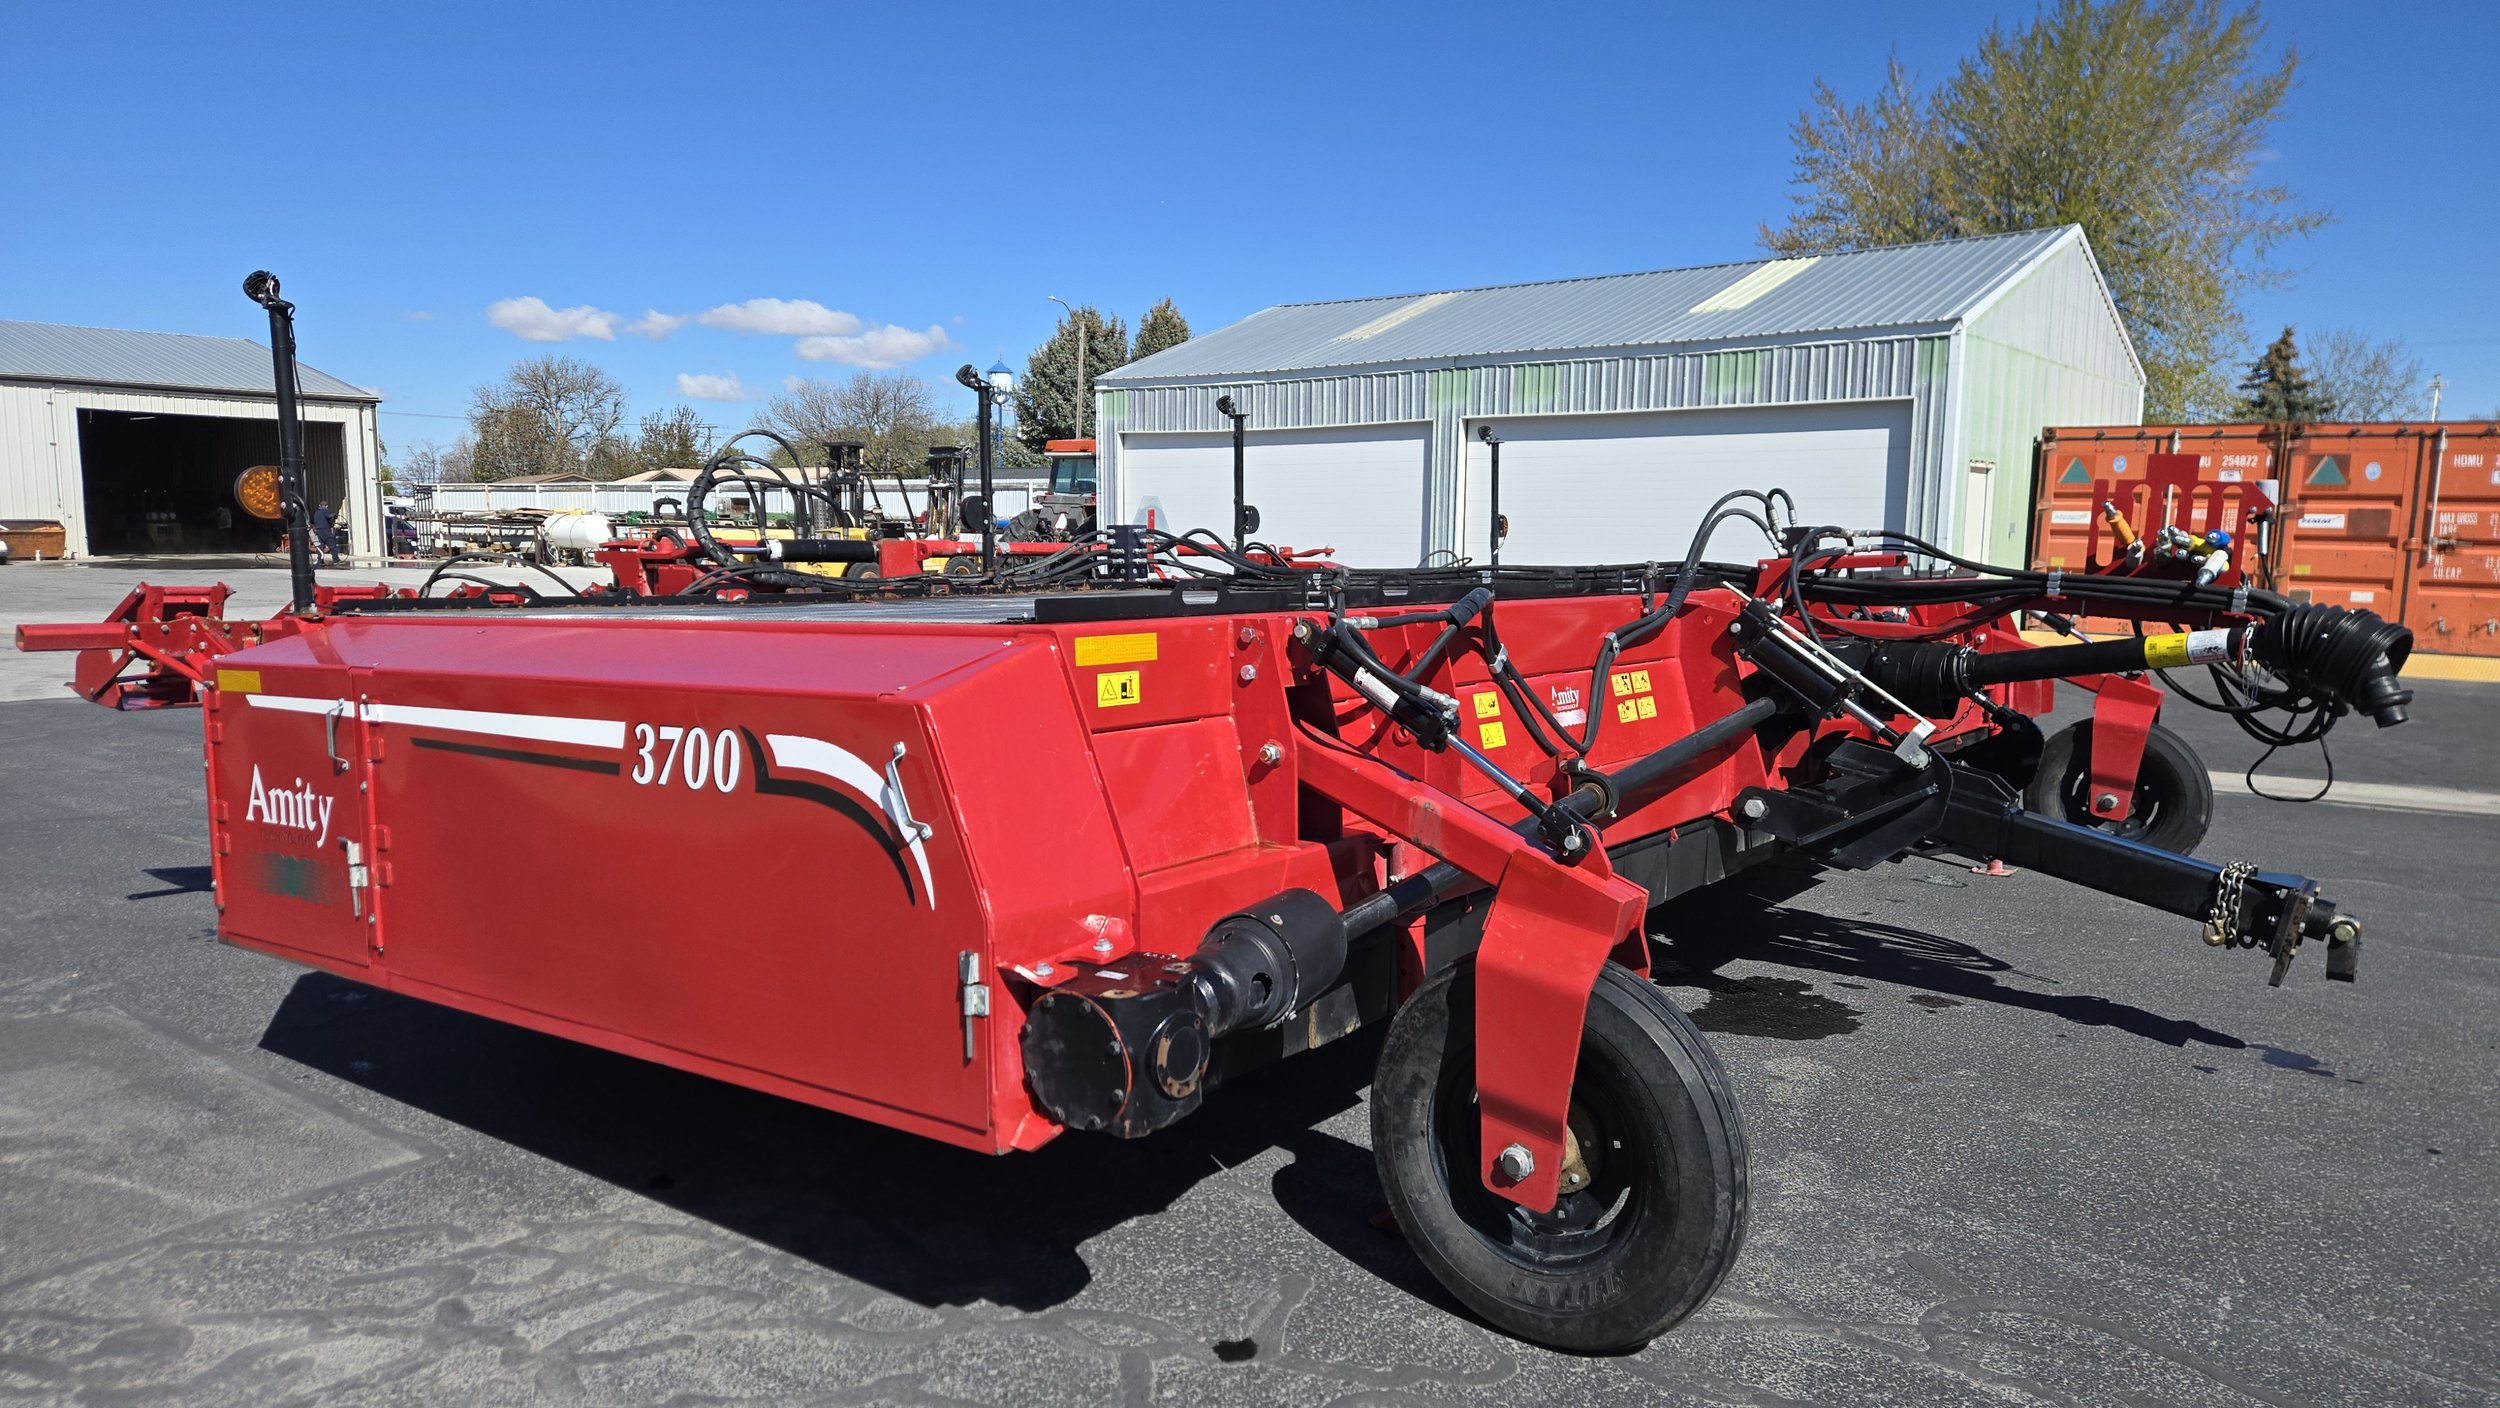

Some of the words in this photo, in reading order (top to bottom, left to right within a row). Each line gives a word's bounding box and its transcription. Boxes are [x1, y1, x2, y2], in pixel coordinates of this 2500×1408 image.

[2453, 454, 2483, 468] HDMU
[631, 722, 740, 793] 3700
[245, 763, 334, 848] Amity
